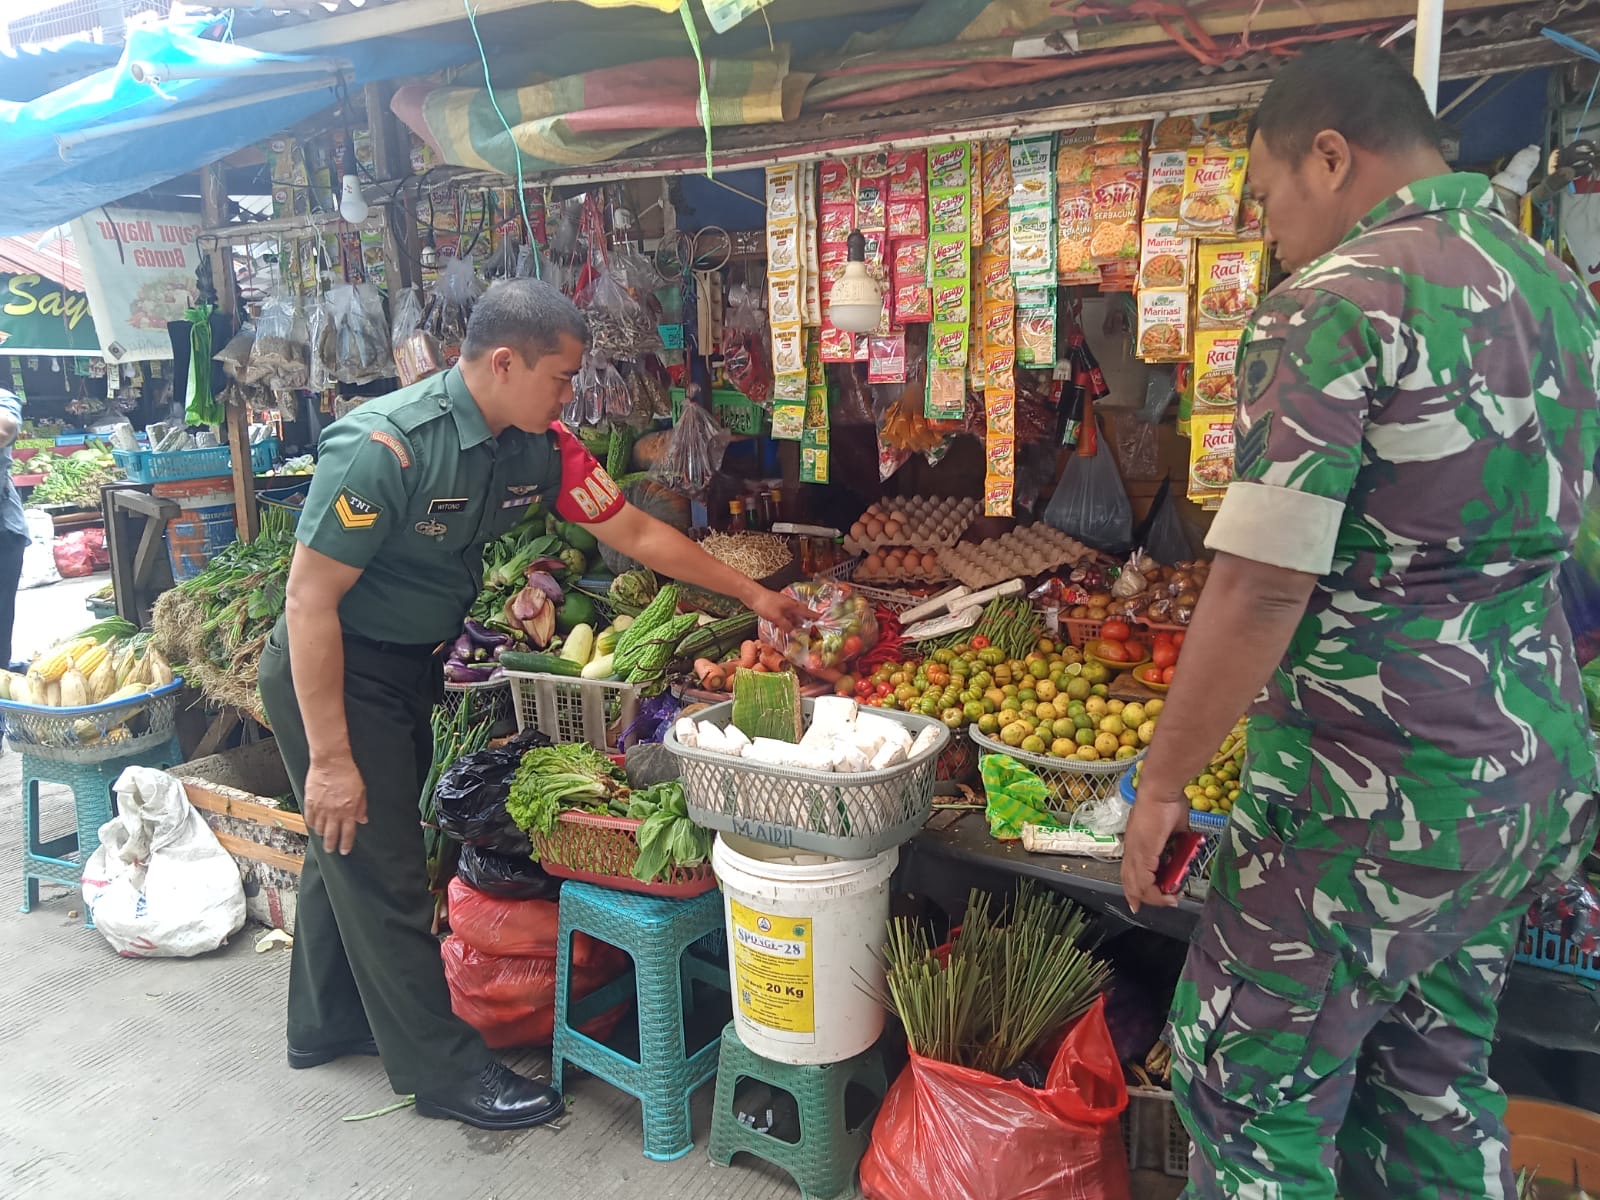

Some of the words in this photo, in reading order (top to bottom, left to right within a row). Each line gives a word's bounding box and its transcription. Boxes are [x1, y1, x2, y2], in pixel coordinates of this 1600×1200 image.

[1193, 166, 1232, 184] Racik
[860, 189, 878, 199] AORI
[1143, 308, 1181, 316] Marinasi
[1206, 347, 1236, 365] Raci
[1202, 431, 1234, 449] Raci
[349, 496, 371, 513] TNI
[766, 982, 781, 994] 20
[785, 986, 804, 999] Kg
